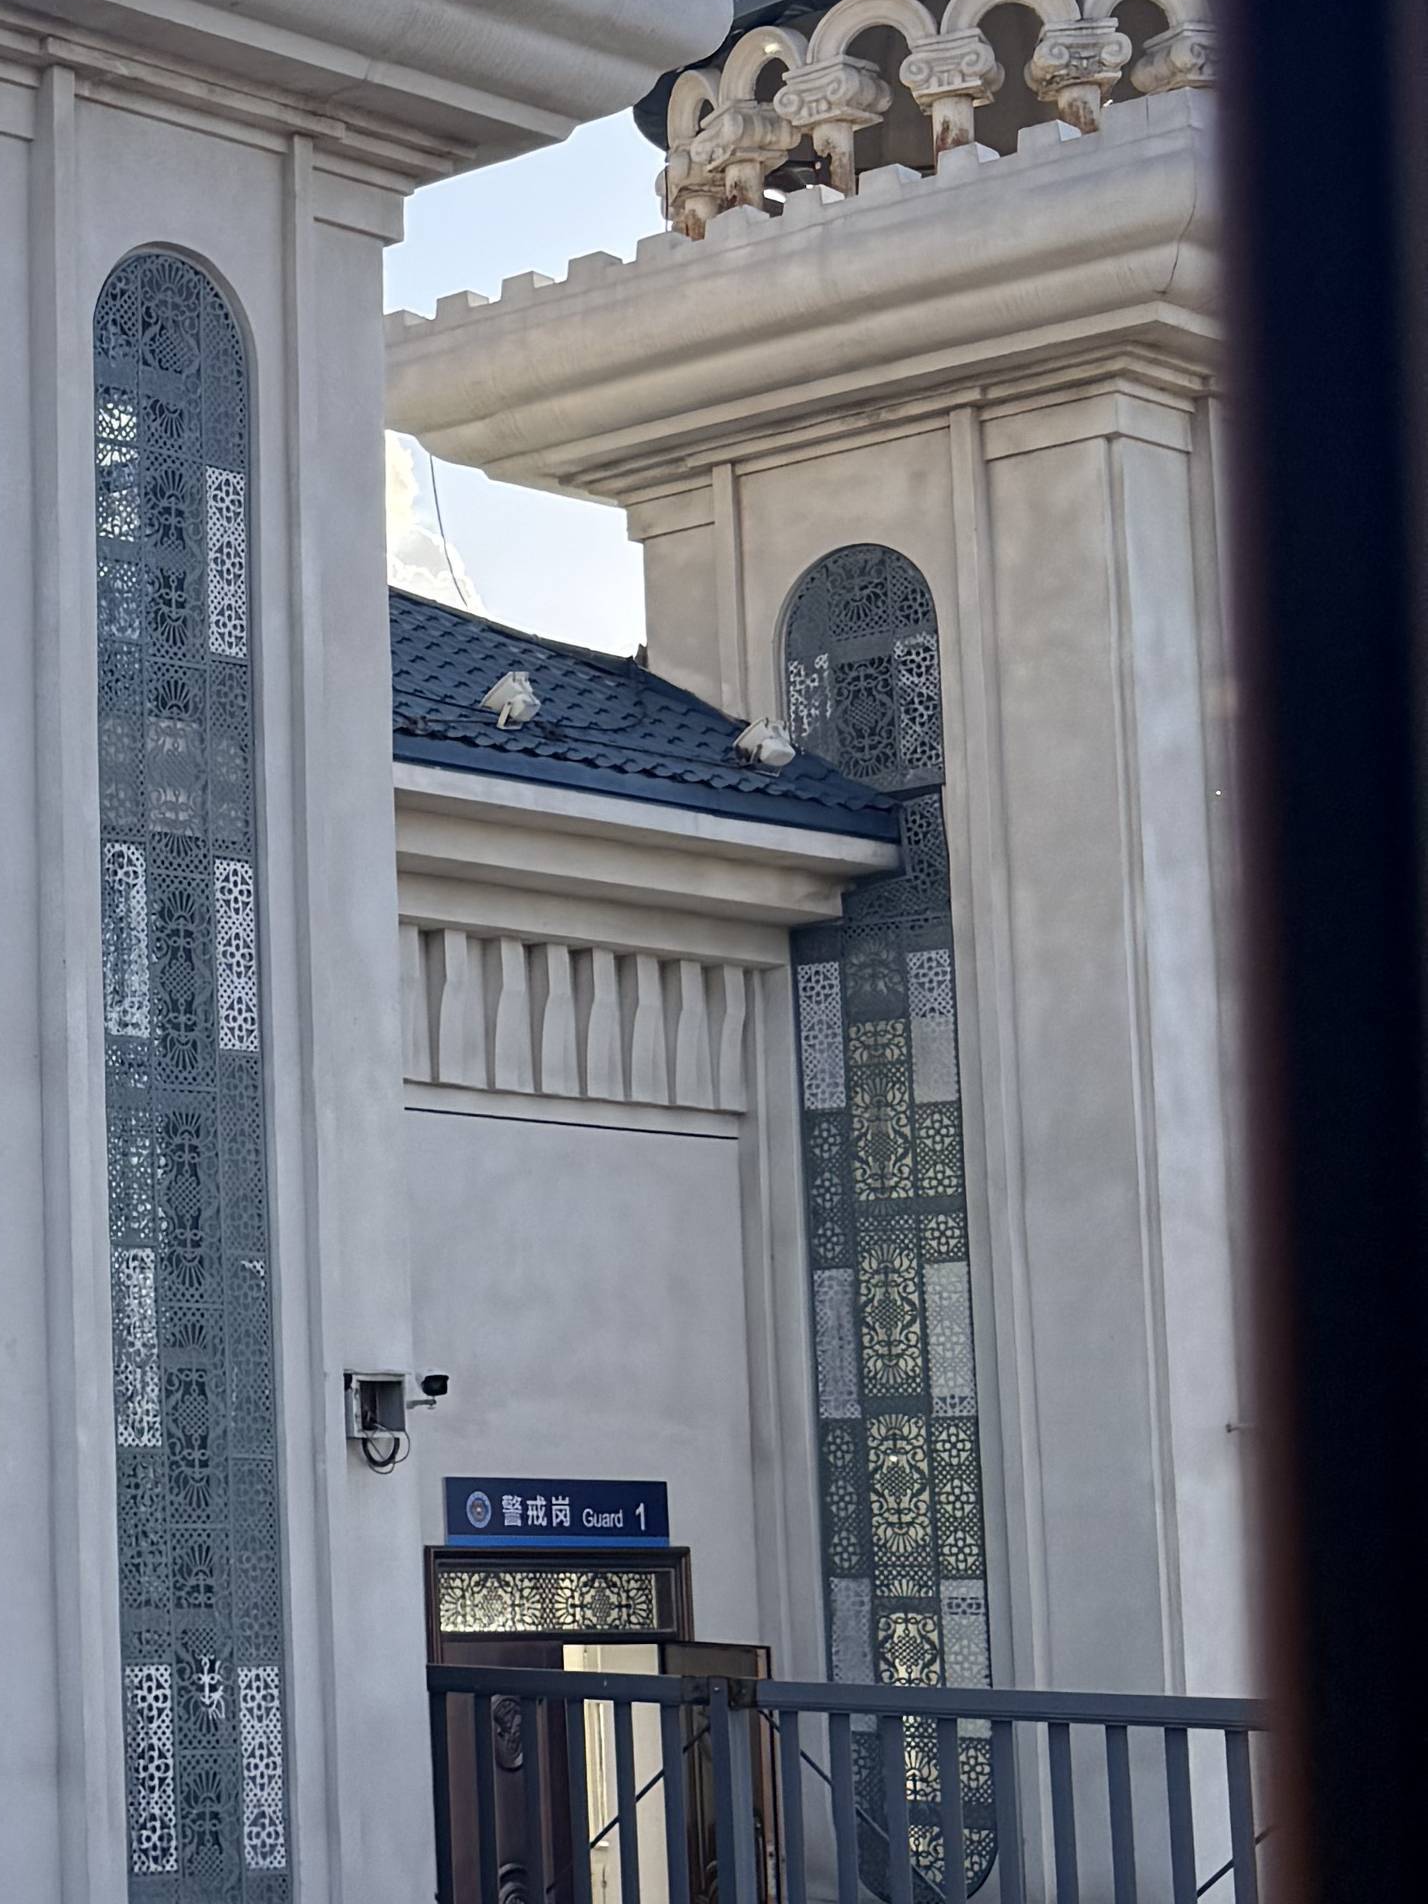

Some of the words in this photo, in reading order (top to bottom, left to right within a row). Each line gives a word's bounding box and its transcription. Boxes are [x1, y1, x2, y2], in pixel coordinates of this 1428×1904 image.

[501, 1495, 570, 1527] 警戒岗
[582, 1508, 624, 1528] Guard
[635, 1502, 646, 1531] 1
